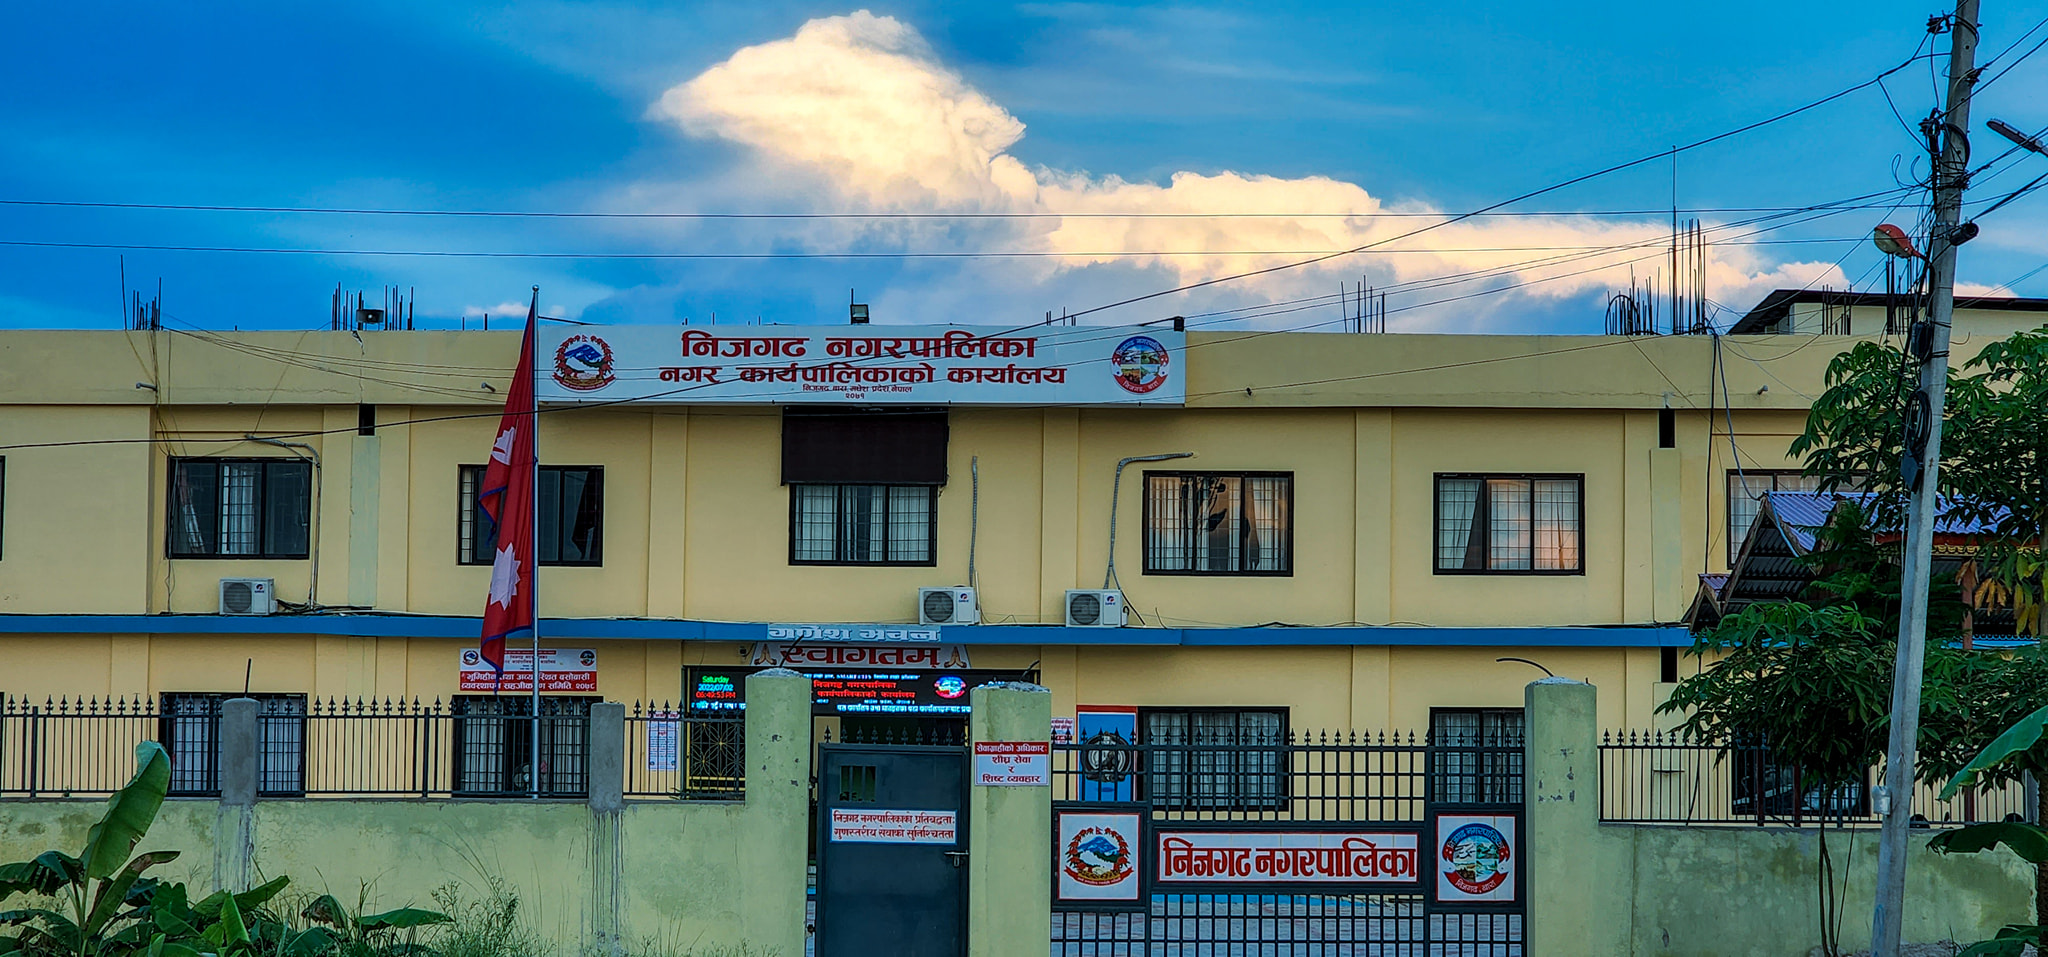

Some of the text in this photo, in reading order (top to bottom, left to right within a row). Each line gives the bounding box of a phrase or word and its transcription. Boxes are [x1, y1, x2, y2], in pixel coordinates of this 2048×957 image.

[681, 330, 1038, 358] निजगढ नगरपालिका
[659, 362, 1067, 384] नगर कार्यपालिकाको कार्यालय
[780, 645, 941, 668] स्वागतम्
[1014, 754, 1031, 764] सेवा
[1163, 837, 1416, 877] निजगढ नगरपालिका
